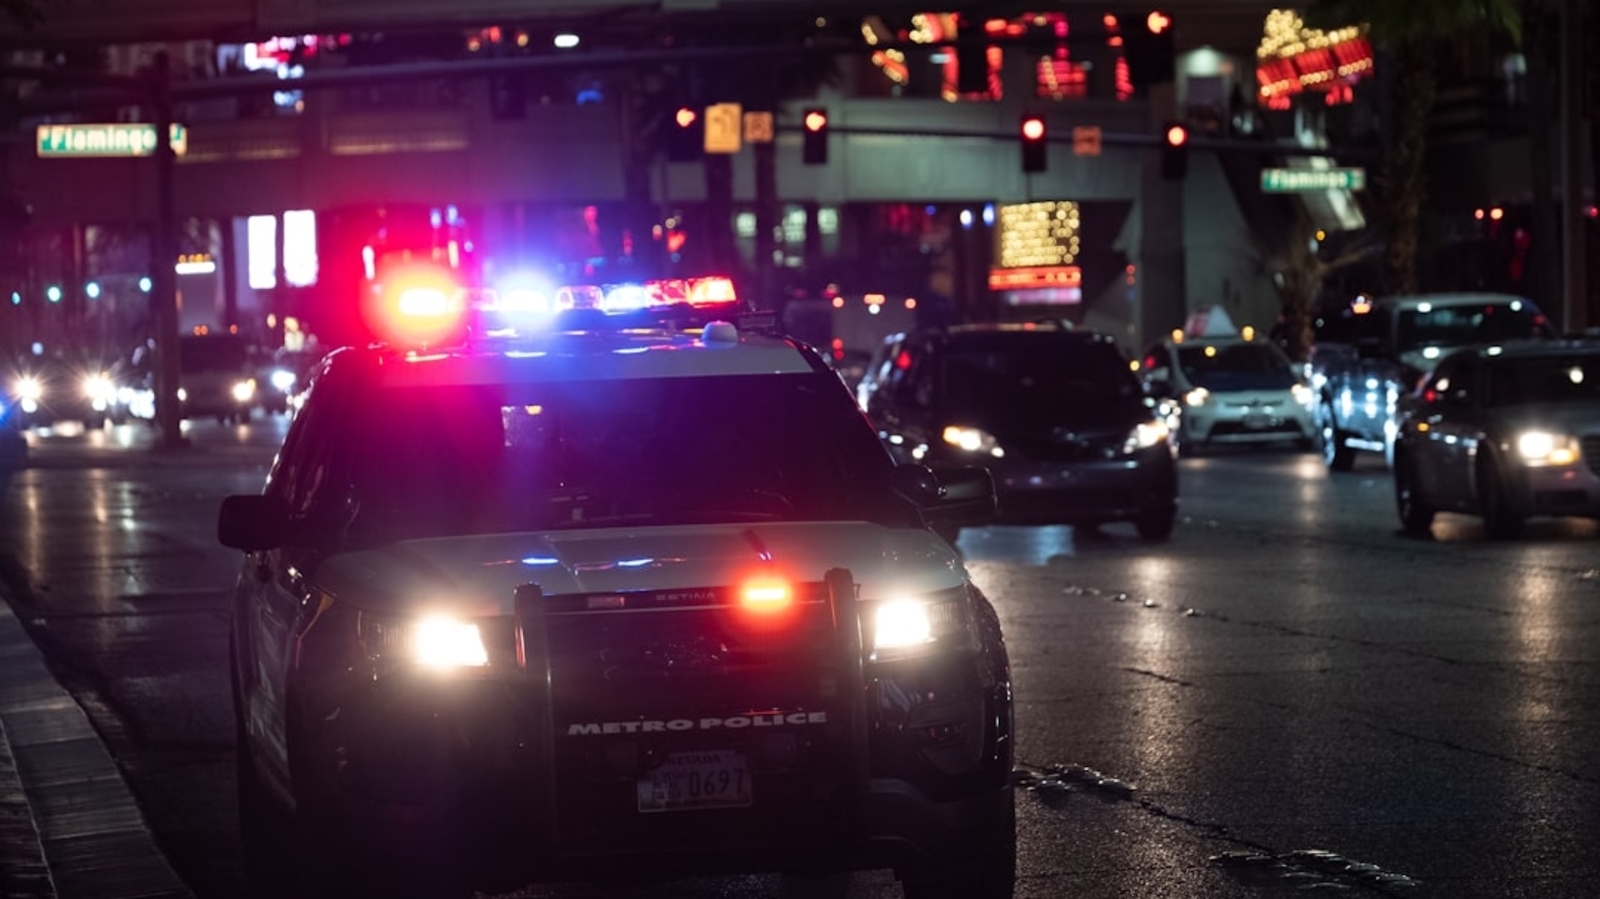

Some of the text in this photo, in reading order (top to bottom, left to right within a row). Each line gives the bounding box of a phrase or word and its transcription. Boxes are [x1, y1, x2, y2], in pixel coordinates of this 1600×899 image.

[50, 125, 157, 155] Flamingo
[1269, 169, 1348, 191] Flamingo
[567, 711, 828, 736] METRO POLICE
[666, 753, 721, 766] NEVADA
[688, 768, 744, 797] 0697
